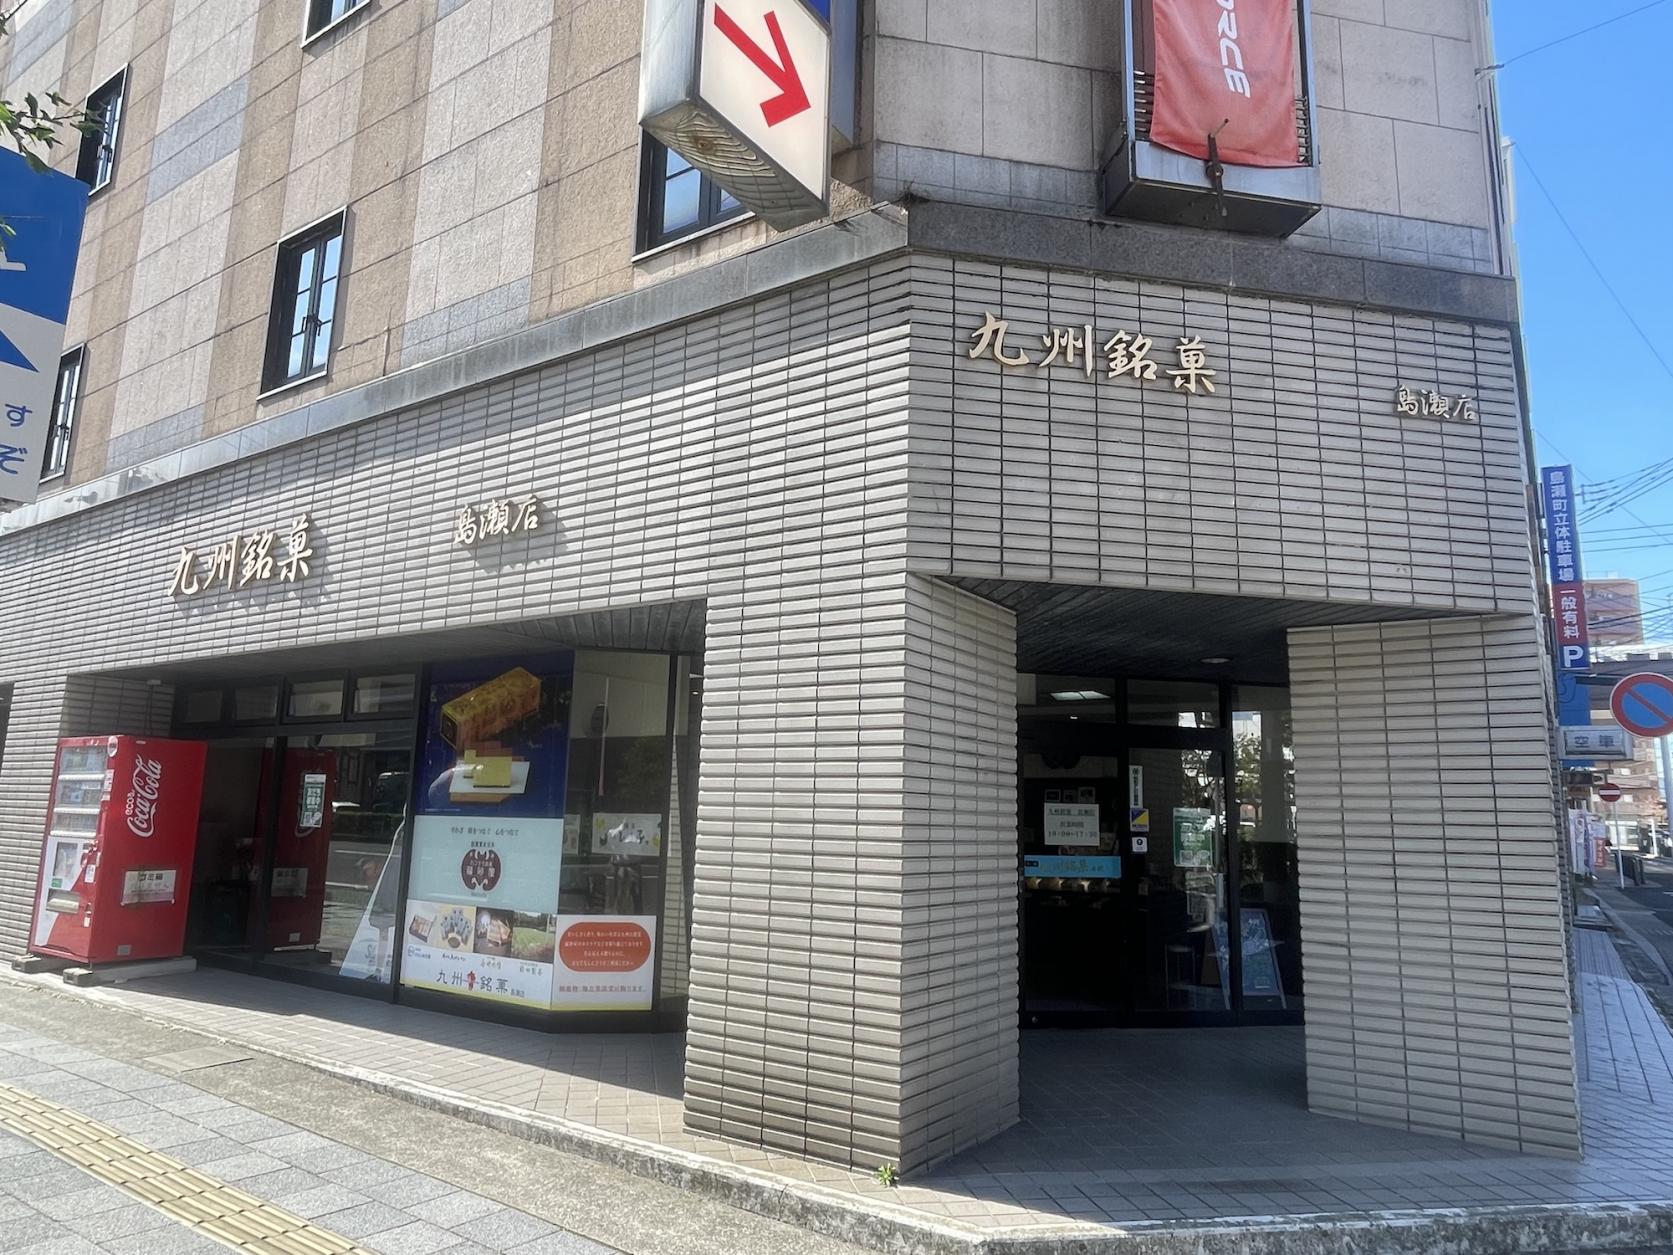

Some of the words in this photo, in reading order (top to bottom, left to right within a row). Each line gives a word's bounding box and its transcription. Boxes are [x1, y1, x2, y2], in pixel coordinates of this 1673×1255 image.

[969, 310, 1217, 393] 九州銘菓
[1397, 384, 1477, 420] 島瀬店
[453, 494, 541, 545] 島瀬店
[1550, 471, 1574, 582] 島瀬町立体駐車場
[168, 513, 313, 597] 九州銘菓
[1560, 589, 1579, 639] 一般有料
[1563, 645, 1584, 668] P
[1574, 735, 1615, 748] 空車
[127, 754, 162, 837] Coca-Cola
